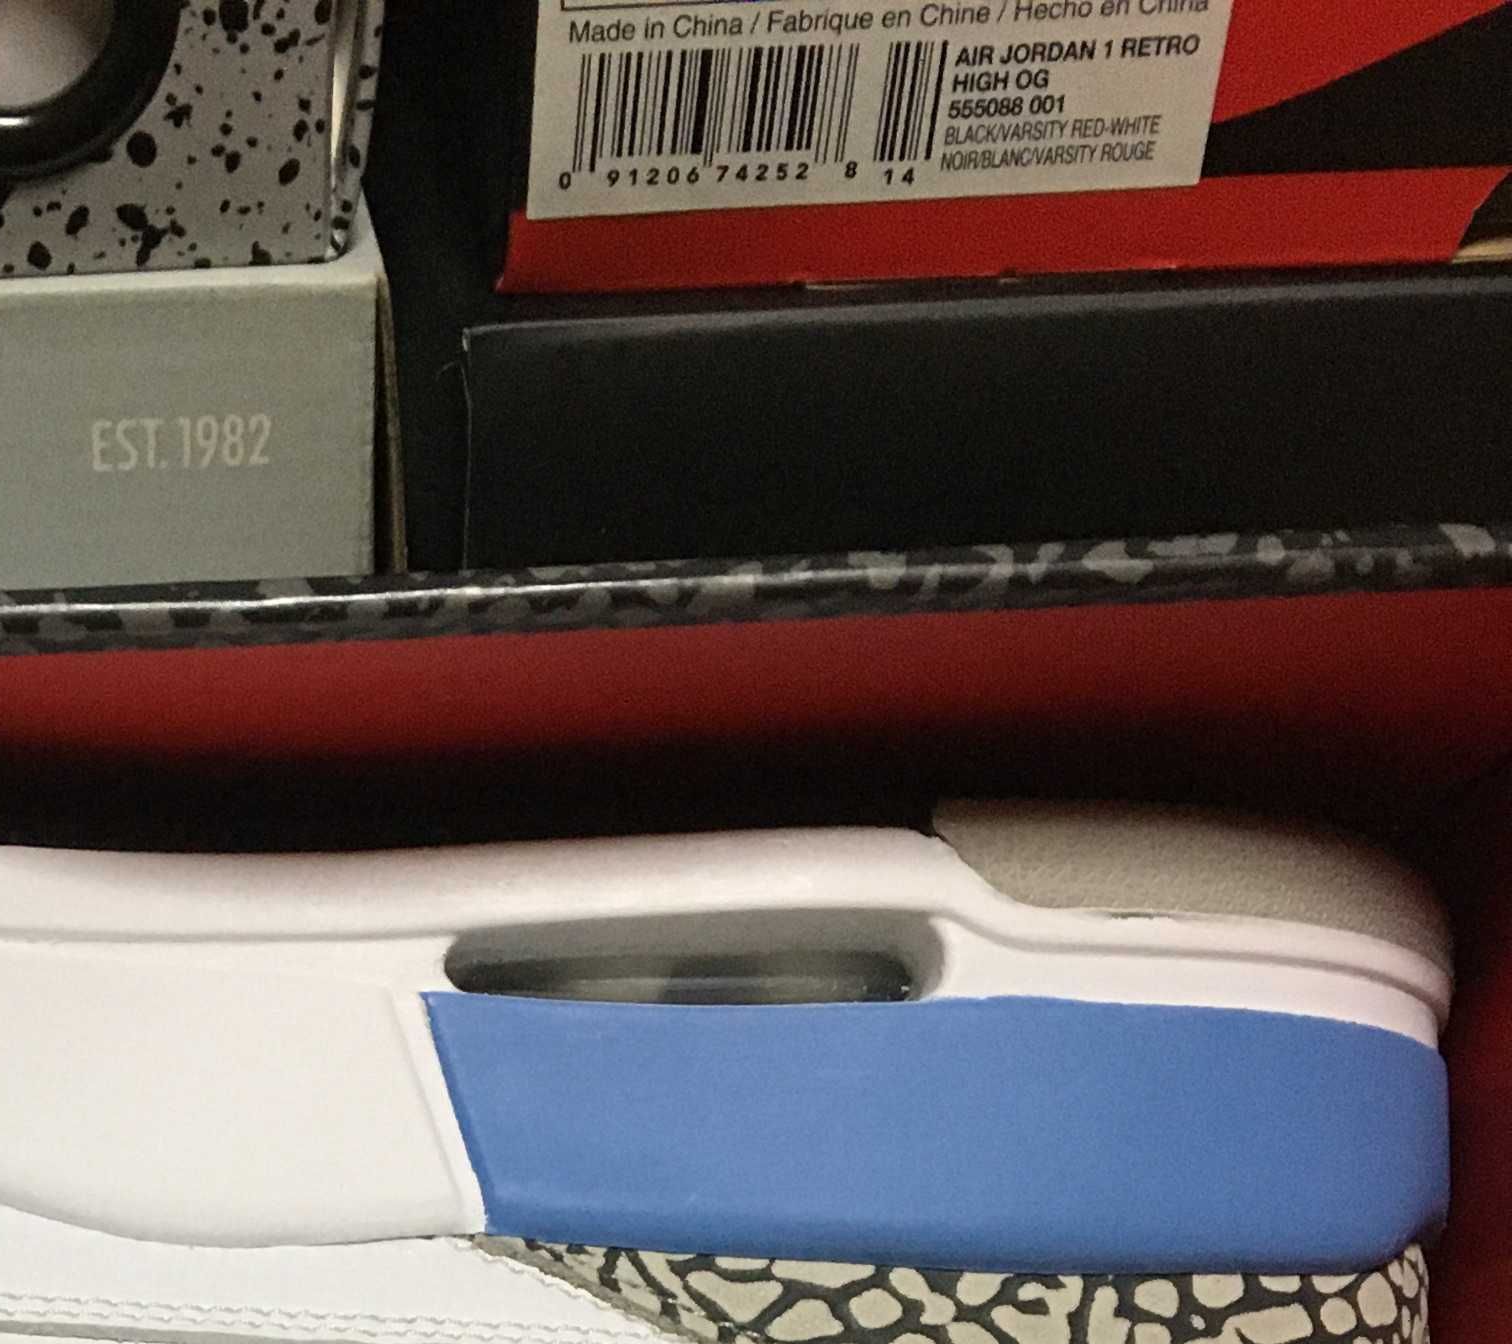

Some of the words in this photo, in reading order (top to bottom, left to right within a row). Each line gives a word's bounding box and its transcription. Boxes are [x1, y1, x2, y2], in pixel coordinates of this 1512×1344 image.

[569, 19, 636, 43] Made
[644, 16, 665, 39] in
[673, 13, 744, 37] China
[750, 11, 760, 34] /
[767, 9, 874, 32] Fabrique
[882, 10, 911, 28] en
[920, 3, 989, 27] Chine
[996, 1, 1006, 22] /
[1014, 0, 1093, 20] Hecho
[1100, 0, 1129, 16] en
[955, 45, 994, 67] AIR
[1000, 41, 1096, 65] JORDAN
[1103, 40, 1113, 60] 1
[1120, 34, 1201, 58] RETRO
[952, 71, 1009, 94] HIGH
[1015, 68, 1050, 90] OG
[948, 97, 1024, 119] 555088
[1029, 94, 1065, 115] 001
[944, 119, 1067, 146] BLACK/VARSITY
[1071, 114, 1163, 140] RED-WHITE
[940, 143, 1097, 171] NOIR/BLANC/VARSITY
[1101, 140, 1157, 163] ROUGE
[179, 413, 273, 469] 1982
